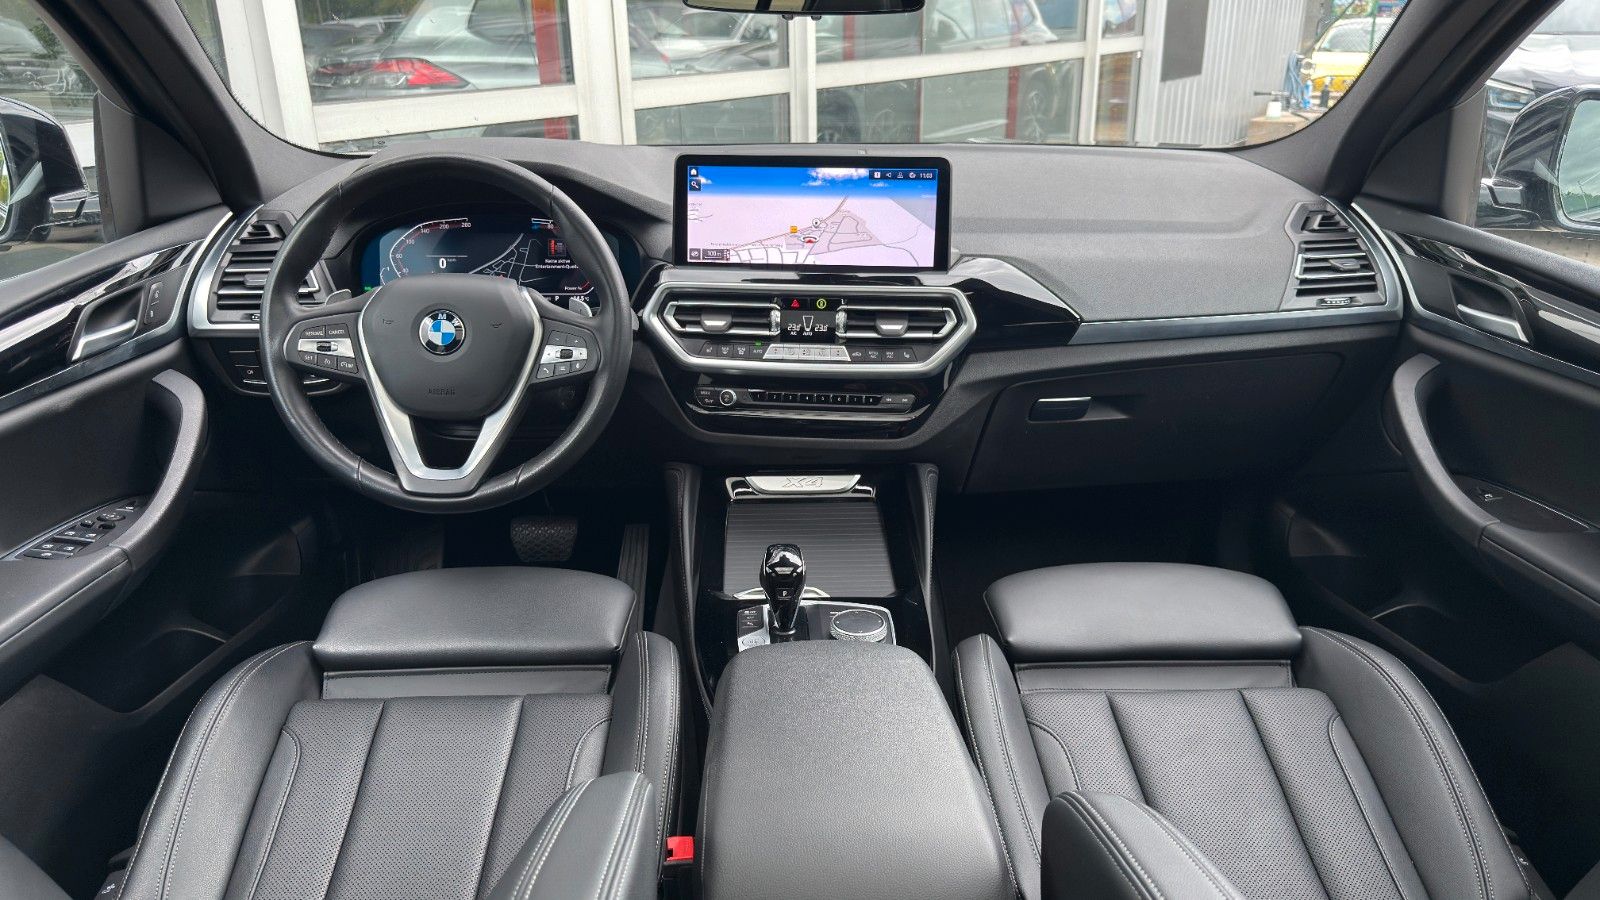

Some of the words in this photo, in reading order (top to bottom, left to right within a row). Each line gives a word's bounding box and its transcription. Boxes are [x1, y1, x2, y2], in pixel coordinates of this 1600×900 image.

[439, 257, 447, 269] 0
[423, 313, 462, 327] BMW
[782, 476, 824, 488] X4
